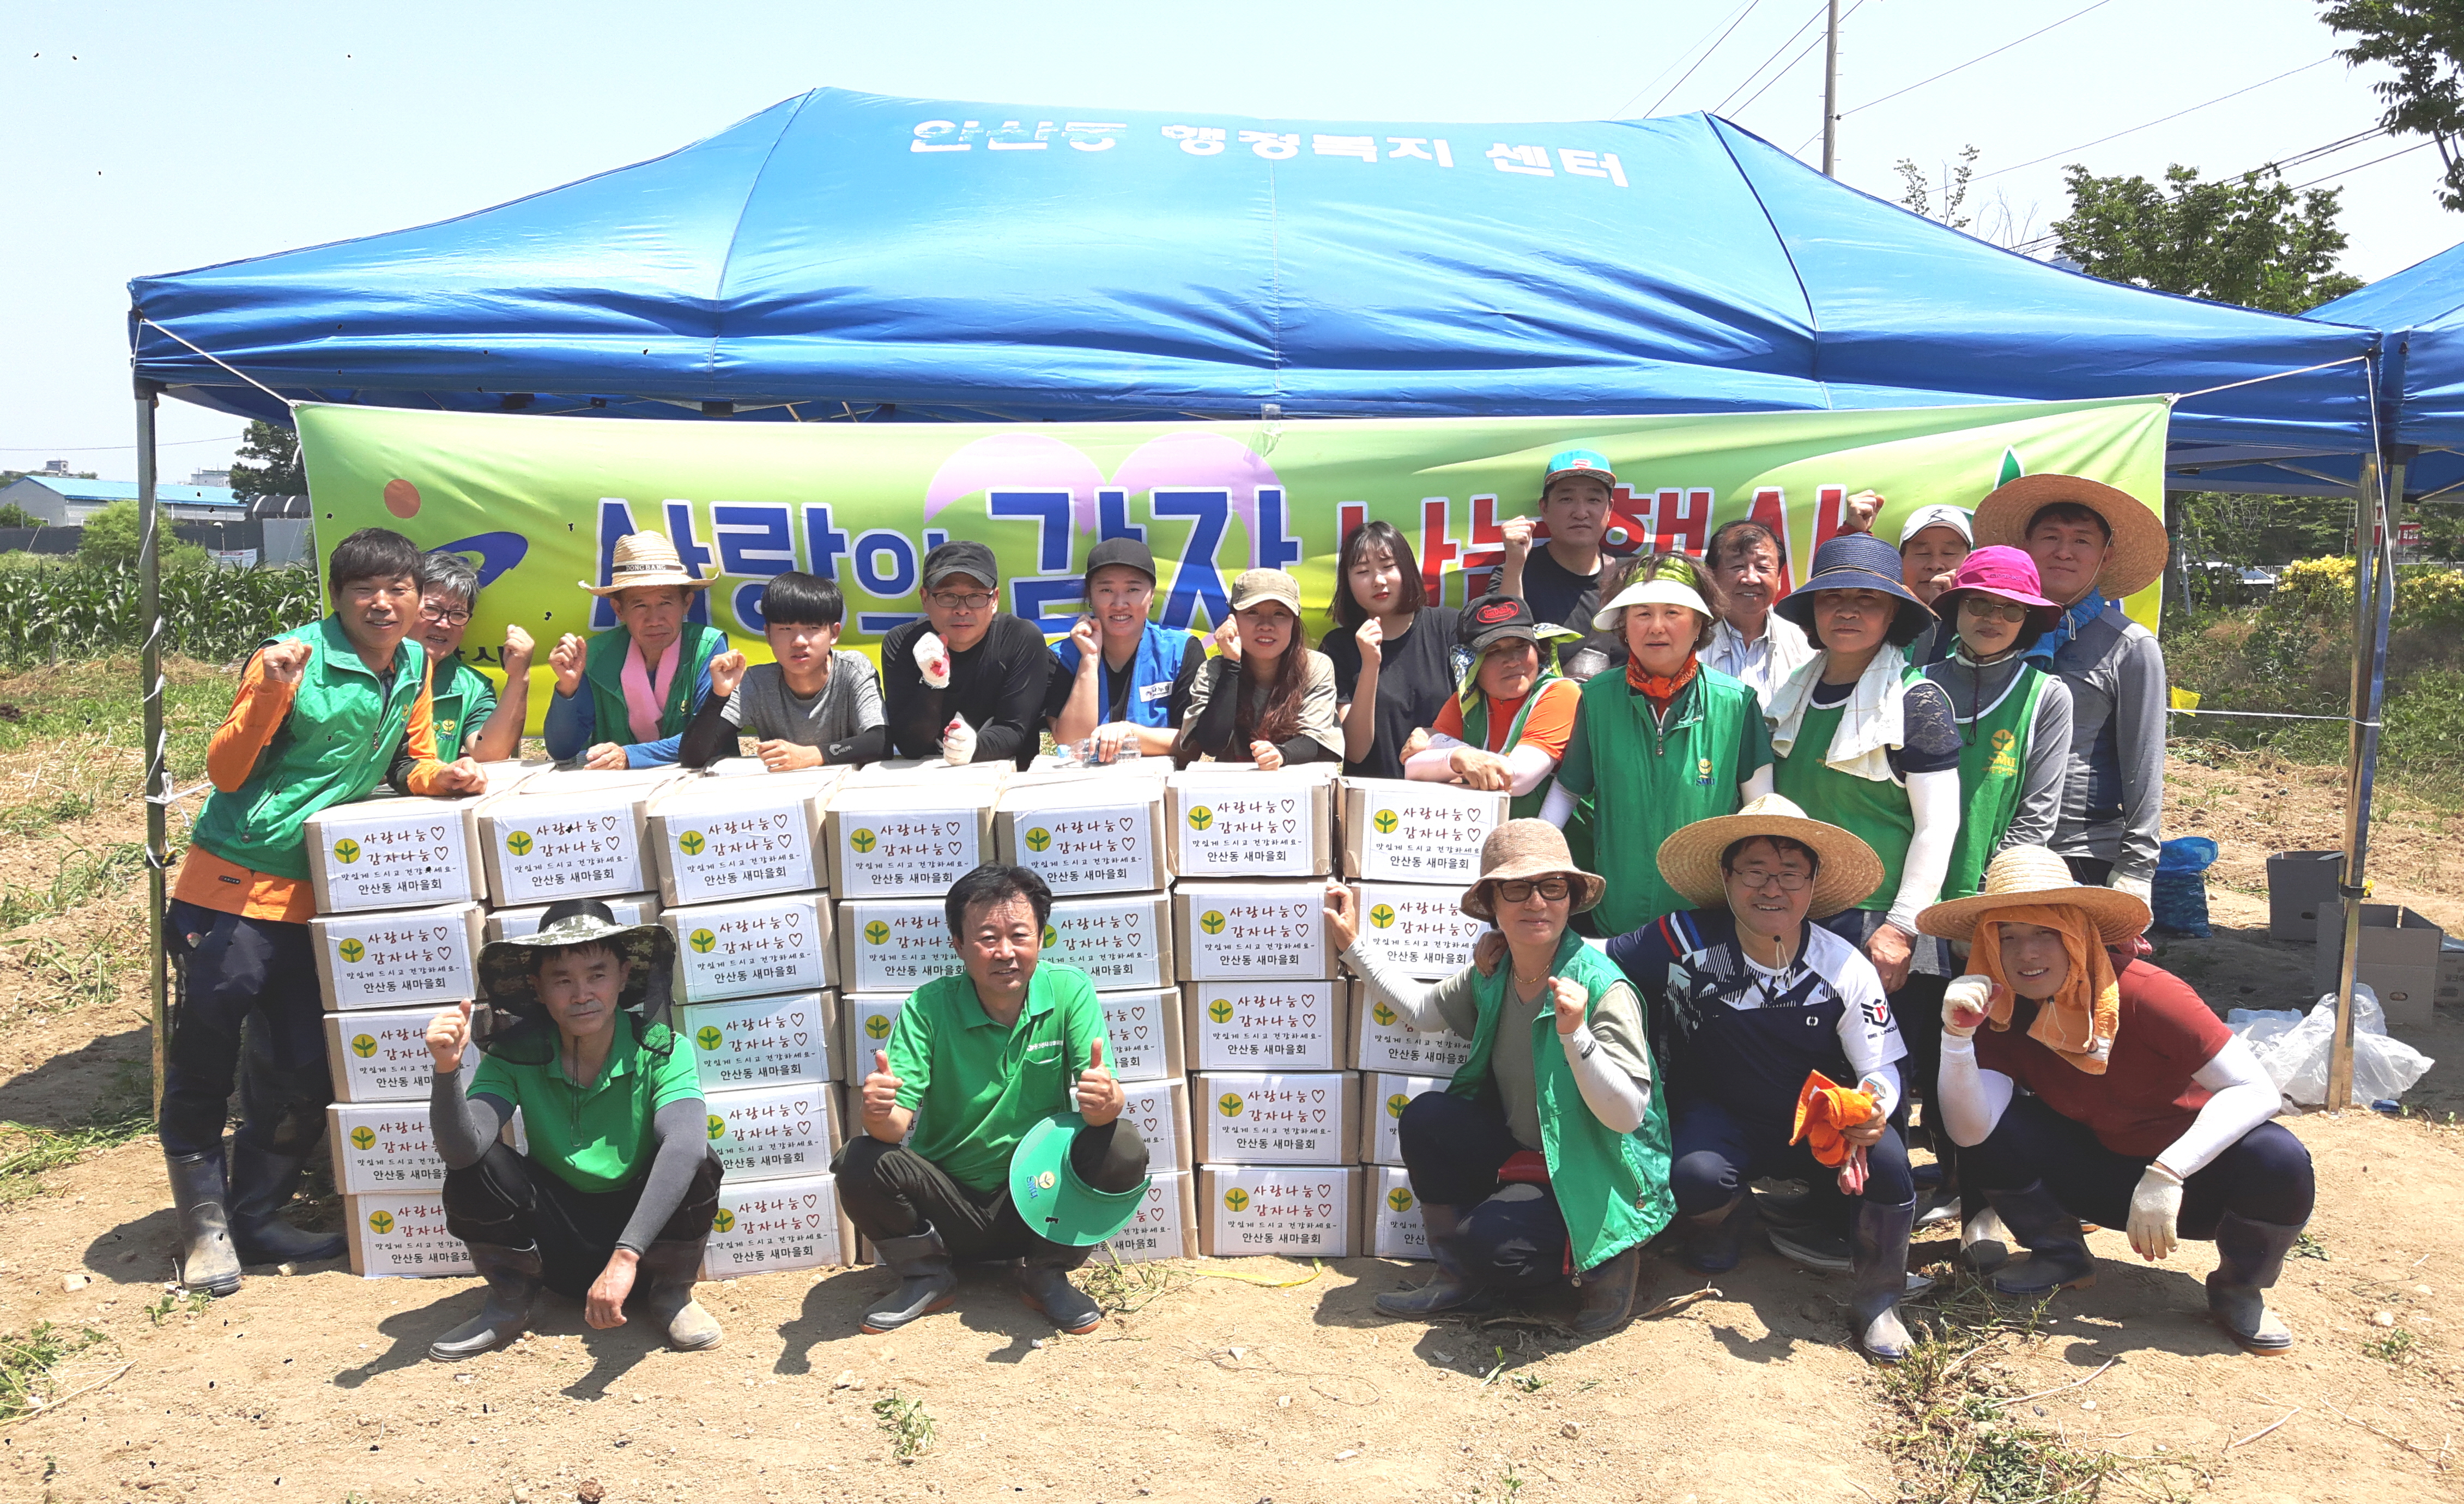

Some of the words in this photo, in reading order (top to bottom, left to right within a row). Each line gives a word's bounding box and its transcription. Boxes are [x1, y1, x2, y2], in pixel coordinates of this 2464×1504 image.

[909, 119, 1128, 153] 안산동
[1485, 141, 1631, 188] 센터
[1696, 778, 1716, 786] SMU
[1216, 800, 1278, 814] 사랑나눔
[1402, 806, 1463, 822] 사랑나눔
[536, 819, 598, 836] 사랑나눔
[708, 817, 770, 835] 사랑나눔
[880, 823, 943, 837] 사랑나눔
[1055, 819, 1116, 834] 사랑나눔
[1218, 820, 1279, 834] 감자나눔
[364, 828, 427, 845] 사랑나눔
[1403, 826, 1463, 842] 감자나눔
[538, 839, 602, 858] 감자나눔
[711, 837, 774, 857] 감자나눔
[881, 842, 945, 857] 감자나눔
[1056, 839, 1118, 855] 감자나눔
[1192, 839, 1219, 847] 맛있게
[1376, 842, 1403, 851] 맛있게
[366, 848, 431, 866] 감자나눔
[1207, 851, 1239, 863] 안산동
[1243, 850, 1286, 863] 새마을회
[1390, 855, 1422, 868] 안산동
[1426, 857, 1469, 870] 새마을회
[514, 864, 543, 874] 맛있게
[547, 860, 573, 870] 드시고
[686, 863, 715, 874] 맛있게
[719, 859, 745, 869] 드시고
[855, 862, 883, 870] 맛있게
[1031, 860, 1058, 869] 맛있게
[341, 872, 370, 882] 맛있게
[373, 870, 400, 878] 드시고
[531, 873, 565, 887] 안산동
[570, 868, 614, 883] 새마을회
[704, 872, 738, 887] 안산동
[742, 865, 786, 882] 새마을회
[871, 873, 905, 885] 안산동
[909, 872, 953, 884] 새마을회
[1046, 870, 1080, 883] 안산동
[1083, 868, 1127, 881] 새마을회
[358, 882, 392, 896] 안산동
[396, 878, 442, 893] 새마을회
[1229, 905, 1290, 919] 사랑나눔
[1399, 901, 1458, 917] 사랑나눔
[719, 916, 782, 933] 사랑나눔
[1060, 915, 1122, 931] 사랑나눔
[1400, 920, 1461, 937] 감자나눔
[367, 929, 430, 944] 사랑나눔
[1230, 925, 1292, 938] 감자나눔
[722, 936, 785, 955] 감자나눔
[1062, 935, 1124, 951] 감자나눔
[1204, 943, 1232, 951] 맛있게
[1372, 937, 1400, 946] 맛있게
[371, 948, 434, 966] 감자나눔
[697, 961, 725, 971] 맛있게
[729, 957, 755, 967] 드시고
[869, 953, 897, 962] 맛있게
[1219, 955, 1252, 966] 안산동
[1256, 954, 1299, 966] 새마을회
[1387, 950, 1419, 963] 안산동
[1423, 952, 1467, 966] 새마을회
[346, 971, 374, 980] 맛있게
[378, 969, 404, 977] 드시고
[714, 970, 748, 984] 안산동
[752, 964, 797, 980] 새마을회
[885, 965, 918, 977] 안산동
[922, 965, 965, 977] 새마을회
[1090, 963, 1133, 977] 새마을회
[363, 981, 397, 994] 안산동
[401, 977, 446, 991] 새마을회
[1237, 994, 1298, 1009] 사랑나눔
[725, 1015, 787, 1032] 사랑나눔
[1238, 1014, 1299, 1028] 감자나눔
[1212, 1032, 1239, 1040] 맛있게
[1374, 1034, 1401, 1044] 맛있게
[1405, 1038, 1430, 1046] 드시고
[728, 1035, 790, 1053] 감자나눔
[1227, 1044, 1260, 1056] 안산동
[1263, 1044, 1306, 1056] 새마을회
[703, 1058, 731, 1068] 맛있게
[735, 1056, 761, 1064] 드시고
[1388, 1048, 1420, 1062] 안산동
[1424, 1051, 1467, 1066] 새마을회
[359, 1066, 387, 1075] 맛있게
[720, 1068, 753, 1081] 안산동
[758, 1063, 801, 1078] 새마을회
[376, 1076, 409, 1088] 안산동
[1247, 1089, 1308, 1103] 사랑나눔
[728, 1103, 791, 1120] 사랑나눔
[1248, 1108, 1309, 1123] 감자나눔
[731, 1124, 794, 1142] 감자나눔
[1221, 1125, 1249, 1133] 맛있게
[738, 1144, 764, 1153] 드시고
[1236, 1137, 1269, 1149] 안산동
[1272, 1138, 1315, 1150] 새마을회
[356, 1158, 384, 1167] 맛있게
[723, 1156, 756, 1170] 안산동
[760, 1151, 804, 1166] 새마을회
[373, 1169, 406, 1181] 안산동
[1253, 1184, 1314, 1198] 사랑나눔
[738, 1197, 800, 1214] 사랑나눔
[1254, 1203, 1315, 1218] 감자나눔
[741, 1217, 803, 1235] 감자나눔
[1227, 1220, 1255, 1228] 맛있게
[1390, 1221, 1417, 1229] 맛있게
[716, 1241, 744, 1250] 맛있게
[748, 1238, 773, 1246] 드시고
[1114, 1238, 1157, 1251] 새마을회
[1242, 1232, 1274, 1244] 안산동
[1278, 1233, 1321, 1245] 새마을회
[374, 1242, 402, 1251] 맛있게
[391, 1253, 424, 1264] 안산동
[428, 1251, 471, 1263] 새마을회
[732, 1250, 766, 1264] 안산동
[770, 1245, 813, 1260] 새마을회
